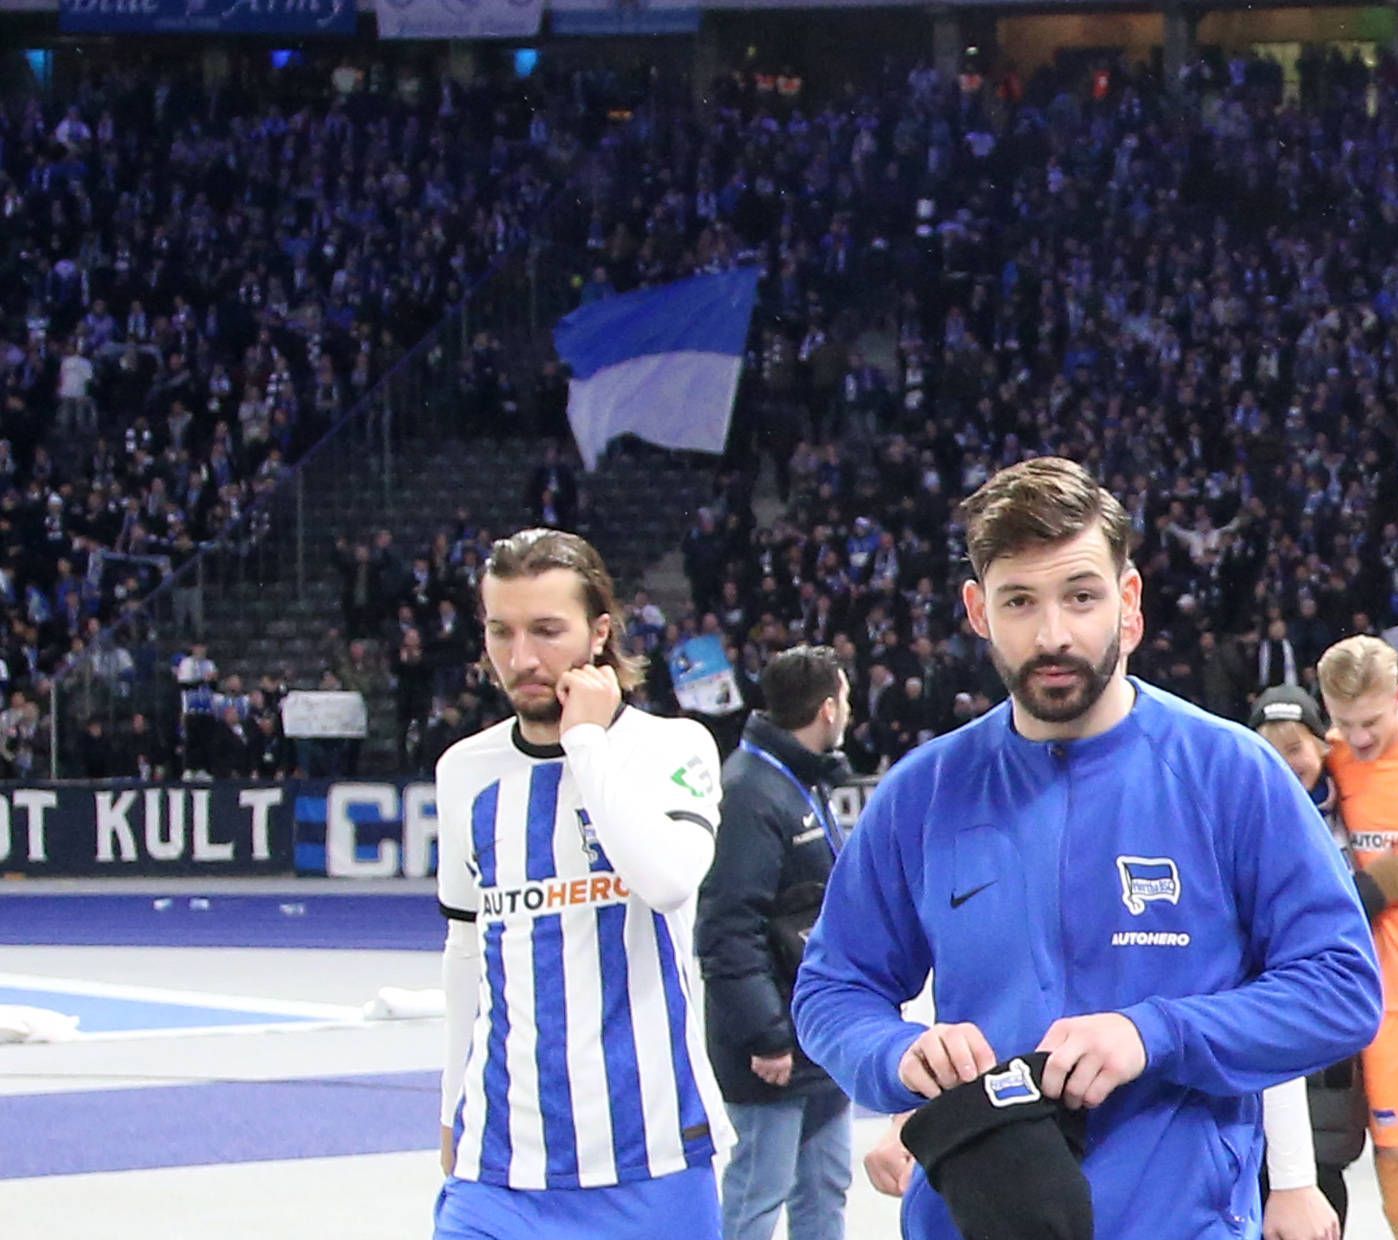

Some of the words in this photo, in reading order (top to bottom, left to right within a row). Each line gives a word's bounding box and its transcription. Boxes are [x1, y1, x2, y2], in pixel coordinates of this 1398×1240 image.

[0, 787, 58, 863] T
[95, 787, 283, 863] KULT
[1111, 932, 1190, 946] AUTOHERO
